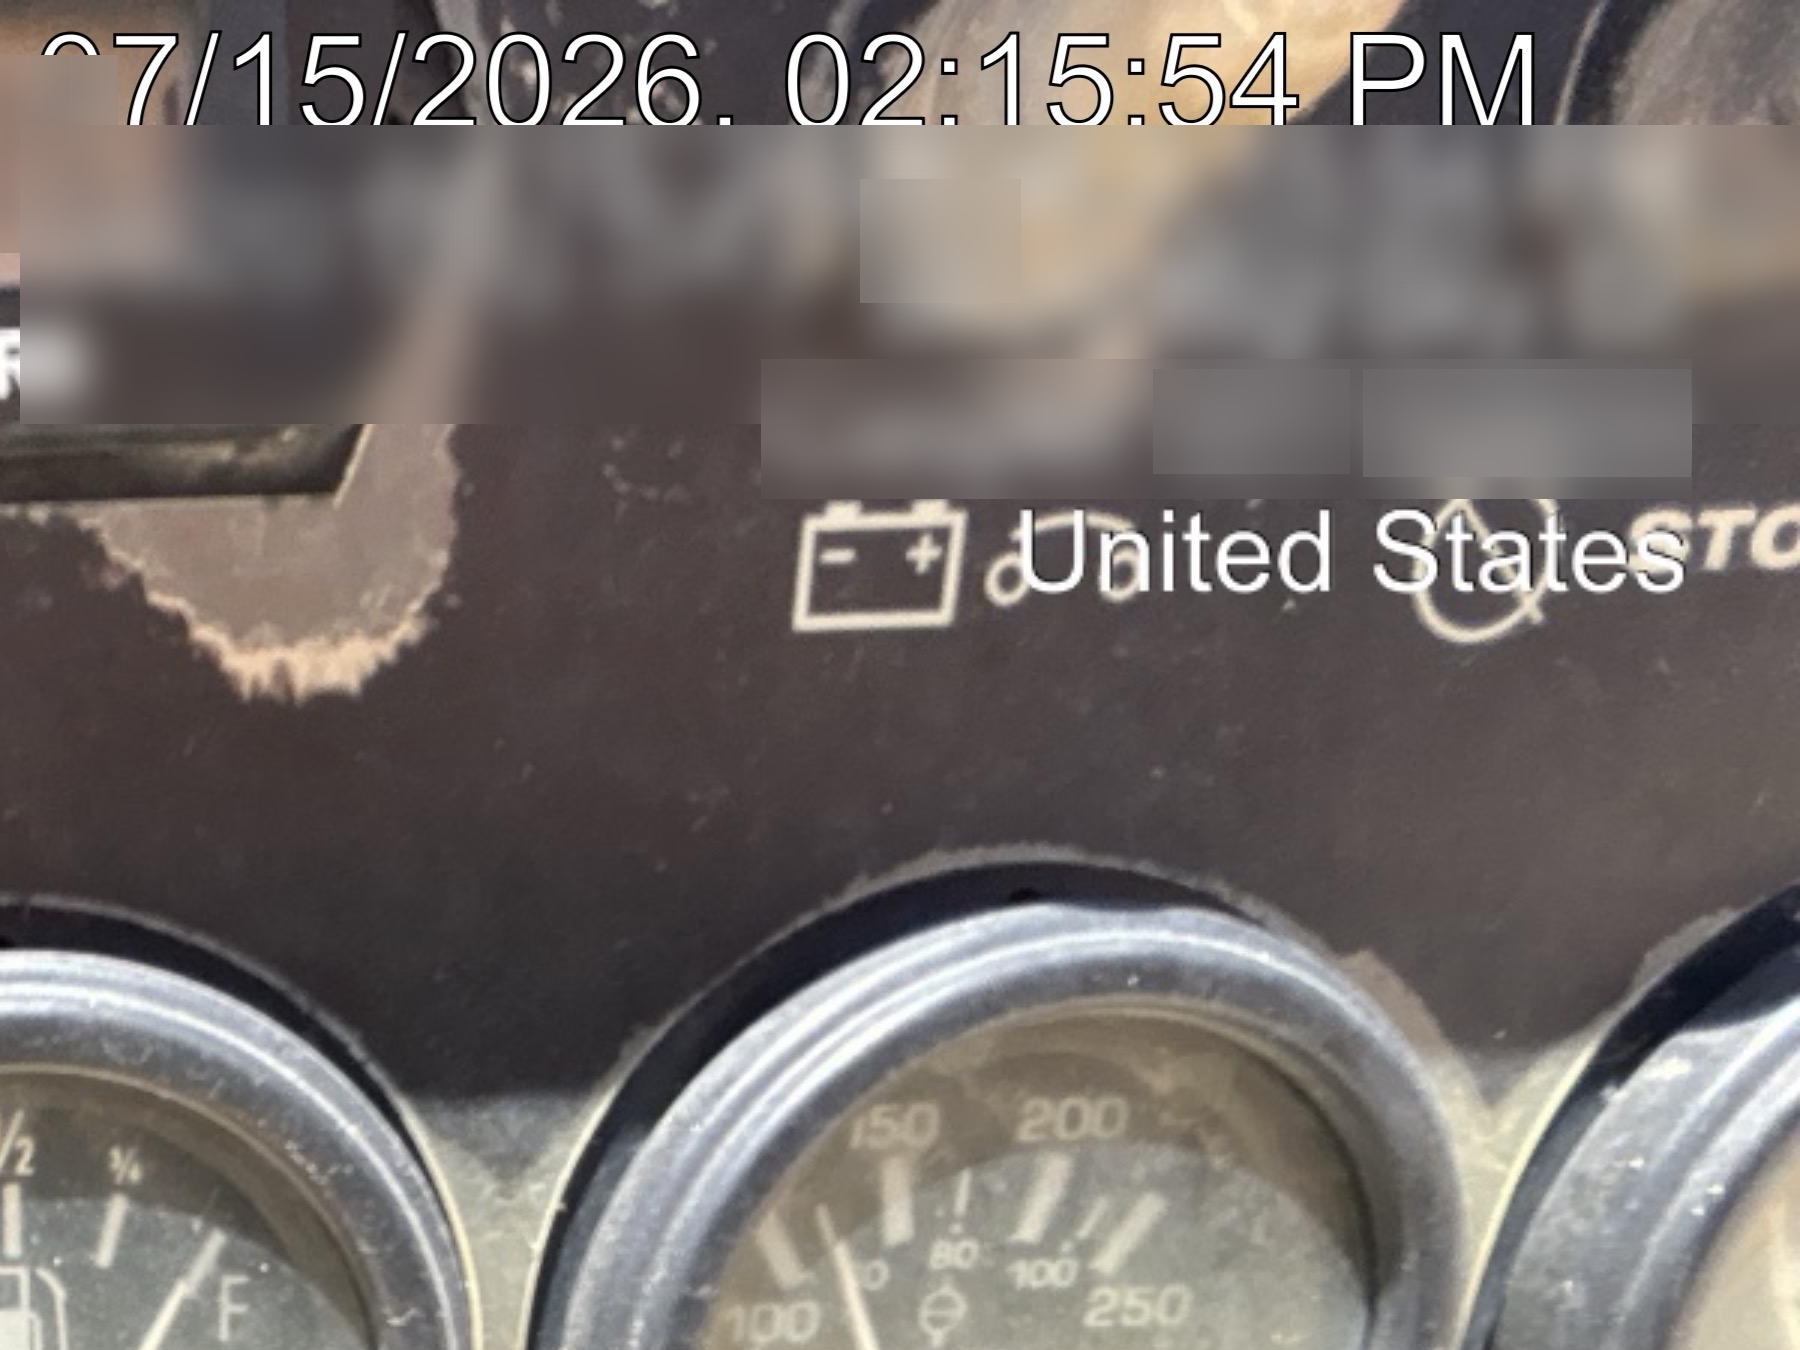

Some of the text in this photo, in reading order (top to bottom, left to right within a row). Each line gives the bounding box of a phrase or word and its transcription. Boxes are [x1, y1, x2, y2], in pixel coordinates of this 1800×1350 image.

[1014, 1097, 1129, 1144] 200
[928, 1238, 981, 1271] 80
[1006, 1256, 1079, 1290] 100
[218, 1275, 249, 1342] F
[725, 1299, 821, 1344] 100
[1081, 1284, 1195, 1329] 250
